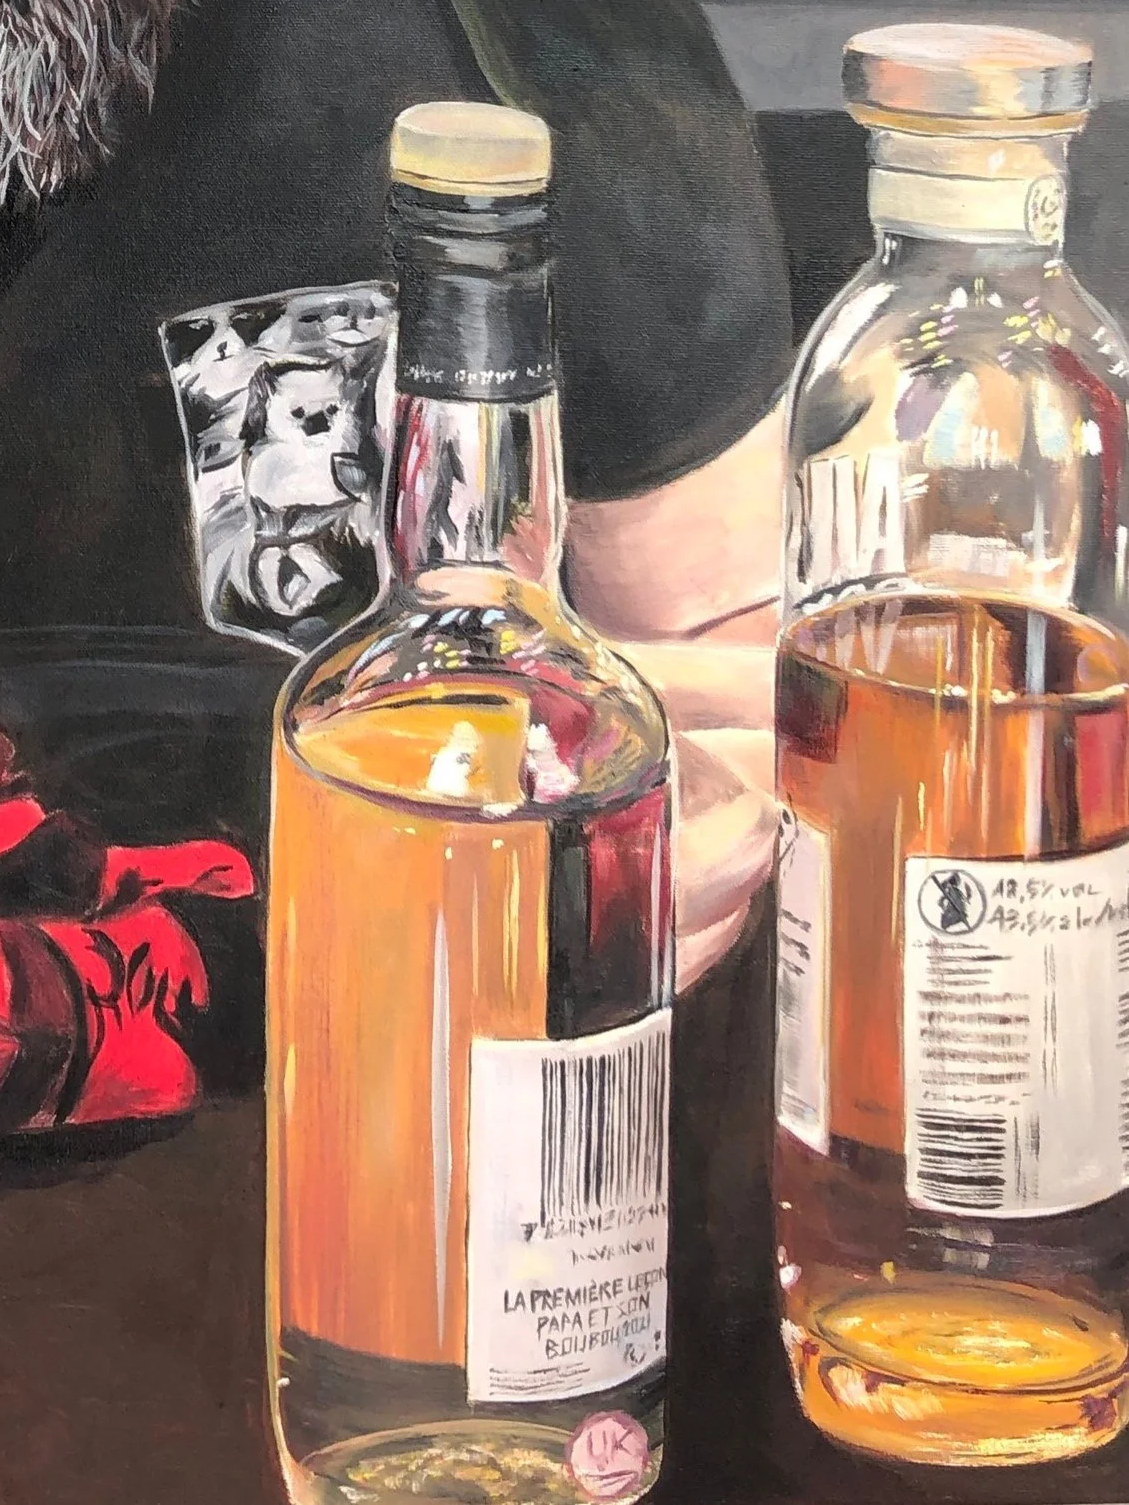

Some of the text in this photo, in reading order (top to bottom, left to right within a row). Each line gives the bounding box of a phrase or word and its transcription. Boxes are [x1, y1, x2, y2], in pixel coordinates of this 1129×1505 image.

[504, 1289, 526, 1313] LA
[530, 1279, 623, 1313] PREMIÈRE
[537, 1312, 582, 1340] PAPA
[589, 1306, 612, 1328] ET
